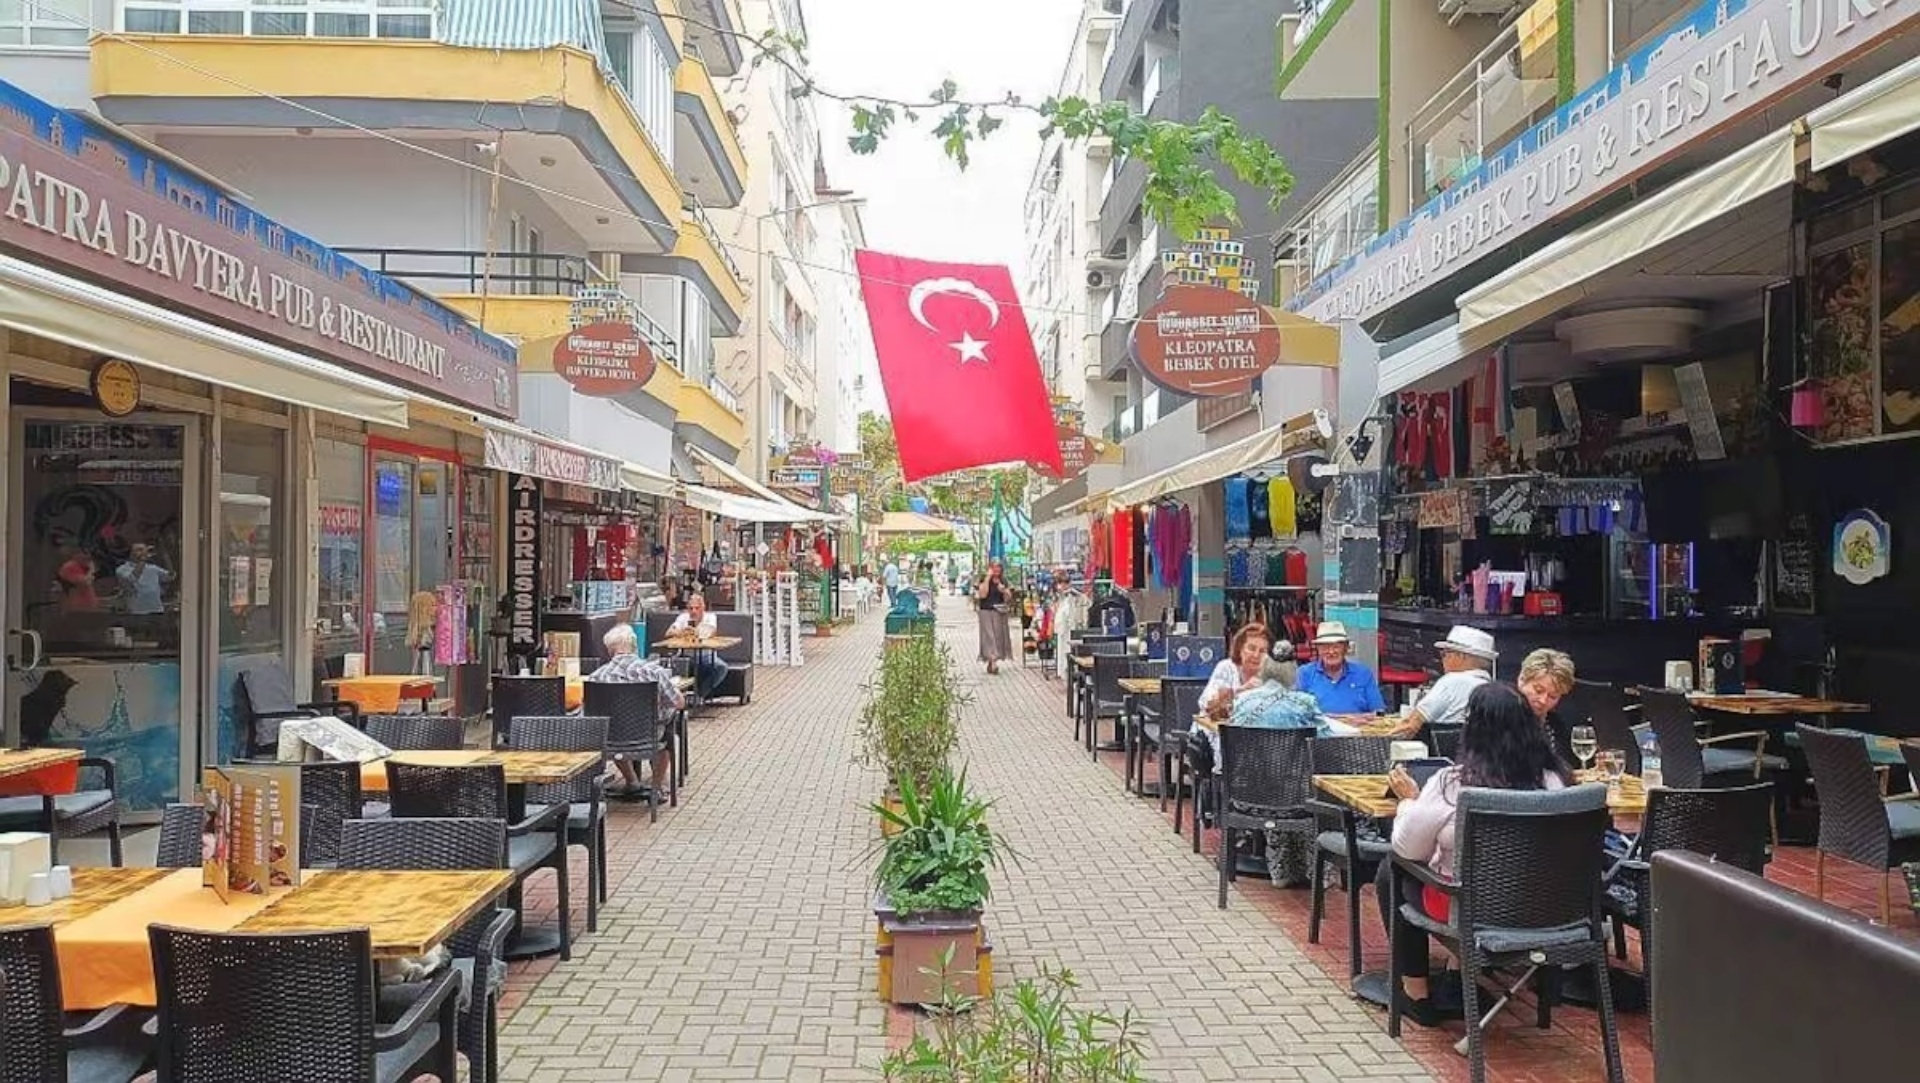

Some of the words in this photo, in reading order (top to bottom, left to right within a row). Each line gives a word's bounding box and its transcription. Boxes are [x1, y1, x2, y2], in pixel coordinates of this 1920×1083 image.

[124, 209, 266, 312] BAVYERA
[268, 273, 316, 329] PUB
[319, 296, 337, 338] &
[338, 303, 445, 380] RESTAURANT
[1323, 246, 1425, 320] KLEOPATRA
[1431, 184, 1512, 272] BEBEK
[1521, 144, 1583, 219] PUB
[1593, 123, 1618, 176] &
[1163, 357, 1214, 372] BEBEK
[1219, 355, 1260, 370] OTEL
[1165, 339, 1256, 355] KLEOPATRA
[512, 476, 536, 643] AIRDRESSER
